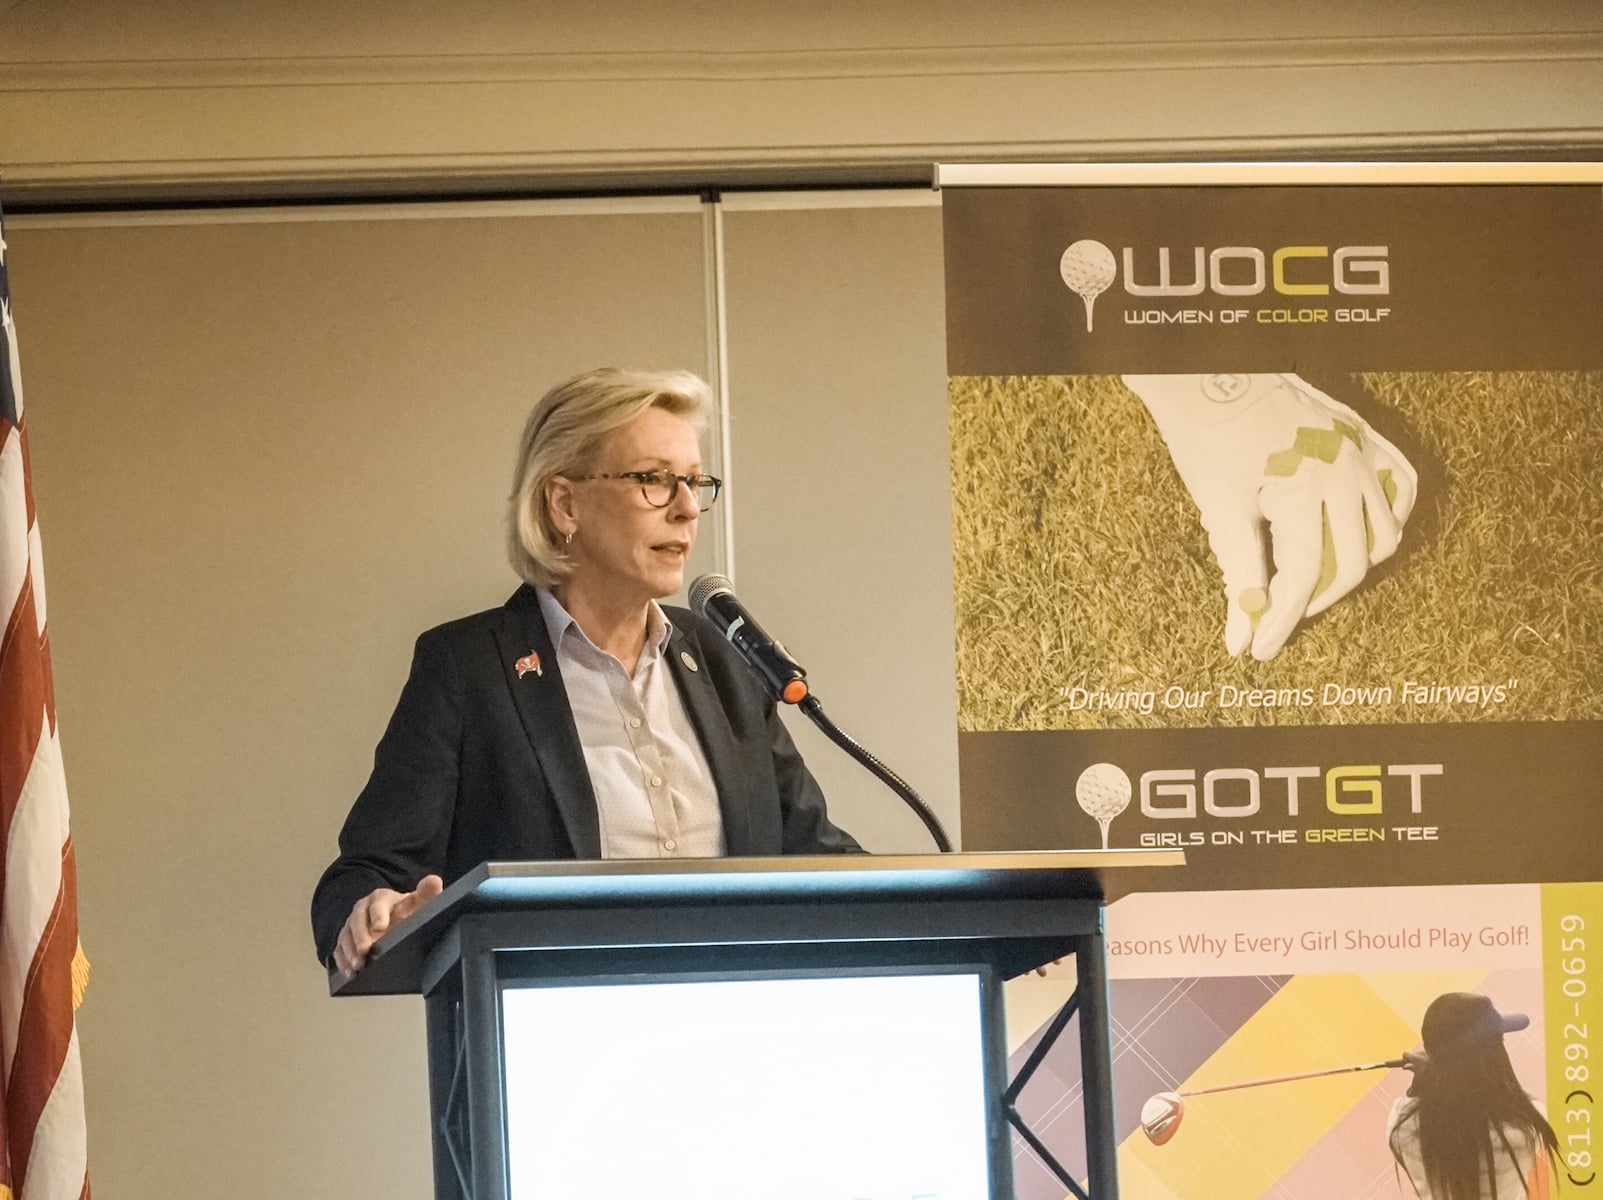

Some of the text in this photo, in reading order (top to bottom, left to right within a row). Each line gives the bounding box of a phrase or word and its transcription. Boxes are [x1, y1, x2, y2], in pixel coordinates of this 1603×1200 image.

[1123, 245, 1390, 295] WOCG
[1124, 308, 1392, 325] WOMEN OF COLOR GOLF
[1058, 679, 1518, 714] "Driving Our Dreams Down Fairways"
[1140, 763, 1443, 819] GOTGT
[1139, 826, 1439, 847] GIRLS ON THE GREEN TEE
[1106, 926, 1530, 959] asons Why Every Girl Should Play Golf!
